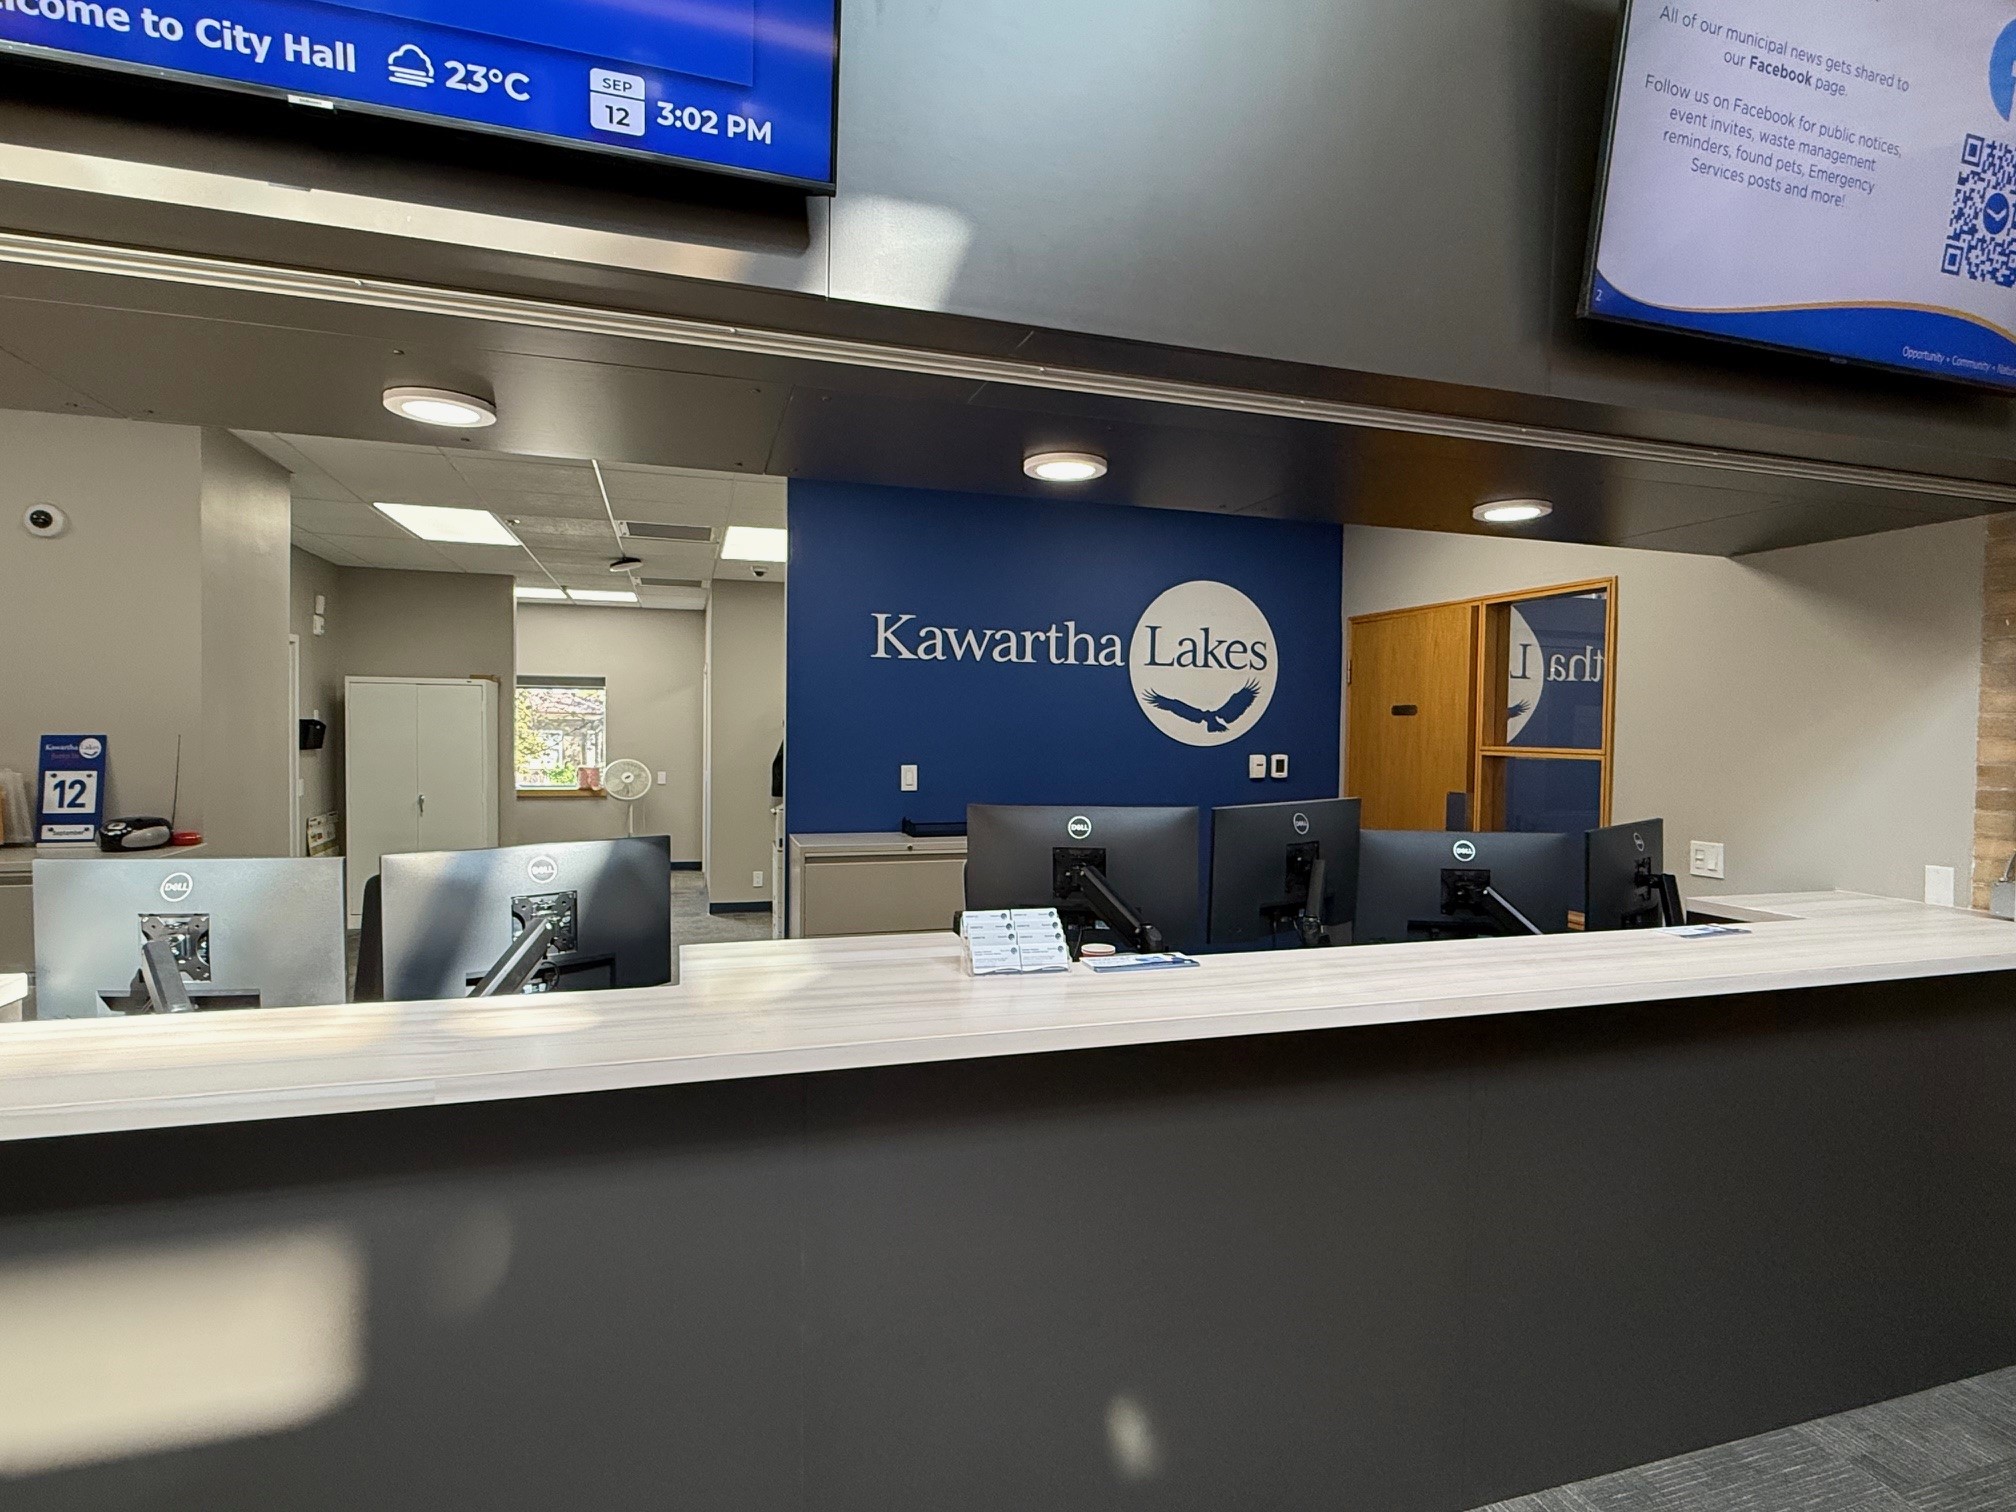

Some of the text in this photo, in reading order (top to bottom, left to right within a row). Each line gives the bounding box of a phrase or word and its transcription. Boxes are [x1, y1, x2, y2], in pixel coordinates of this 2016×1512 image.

[0, 0, 356, 73] come to City Hall
[1659, 5, 1910, 92] All of our municipal news gets shared to
[443, 60, 531, 102] 23°C
[602, 77, 632, 93] SEP
[1724, 51, 1848, 97] our Facebook page.
[605, 105, 630, 127] 12
[656, 100, 772, 145] 3:02 PM
[1644, 74, 1902, 158] Follow us on Facebook for public notices,
[1663, 130, 1876, 195] reminders, found pets, Emergency
[1669, 107, 1877, 172] event invites, waste management
[1690, 157, 1847, 208] Services posts and more!
[1594, 289, 1603, 302] 2
[1902, 346, 1945, 364] Opportunity
[870, 612, 1267, 671] Kawartha Lakes
[53, 779, 87, 808] 12
